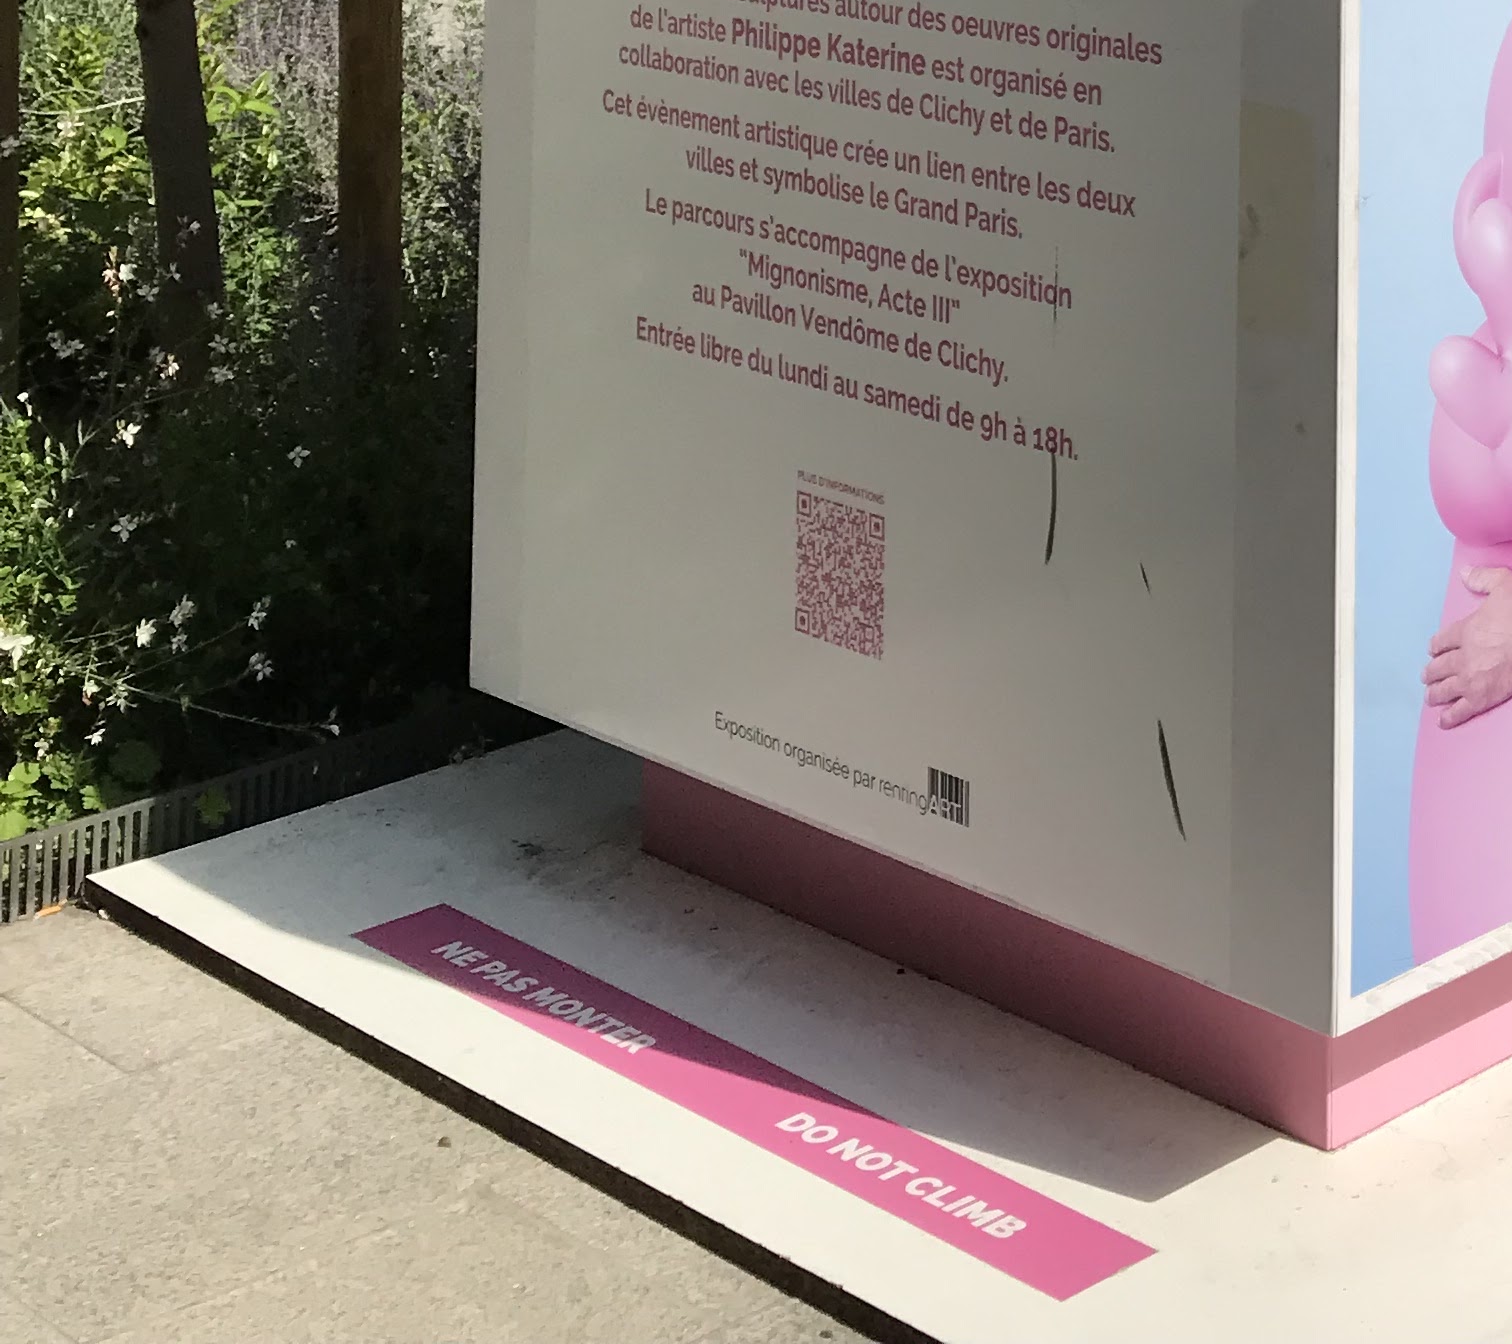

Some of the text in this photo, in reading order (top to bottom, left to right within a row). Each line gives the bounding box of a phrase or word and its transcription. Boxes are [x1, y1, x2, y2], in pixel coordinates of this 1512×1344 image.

[630, 4, 1102, 106] de l'artiste Philippe Katerine est organisé en
[907, 1, 947, 33] des
[951, 14, 1041, 47] oeuvres
[1046, 24, 1163, 65] originales
[618, 43, 1116, 153] collaboration avec les villes de Clichy et de Paris.
[602, 88, 1136, 218] Cet évènement artistique crée un lien entre les deux
[686, 146, 1023, 239] villes et symbolise le Grand Paris.
[645, 188, 1072, 310] Le parcours s'accompagne de l'exposition
[739, 248, 873, 309] "Mignonisme,
[877, 283, 927, 318] Acte
[636, 315, 1079, 461] Entrée libre du lundi au samedi de 9h à 18h.
[692, 284, 1009, 387] au Pavillon Vendôme de Clichy.
[715, 710, 780, 753] Exposition
[783, 742, 850, 779] organisée
[853, 768, 876, 789] par
[430, 940, 656, 1054] NE PAS MONTER
[774, 1112, 1027, 1238] DO NOT CLIMB
